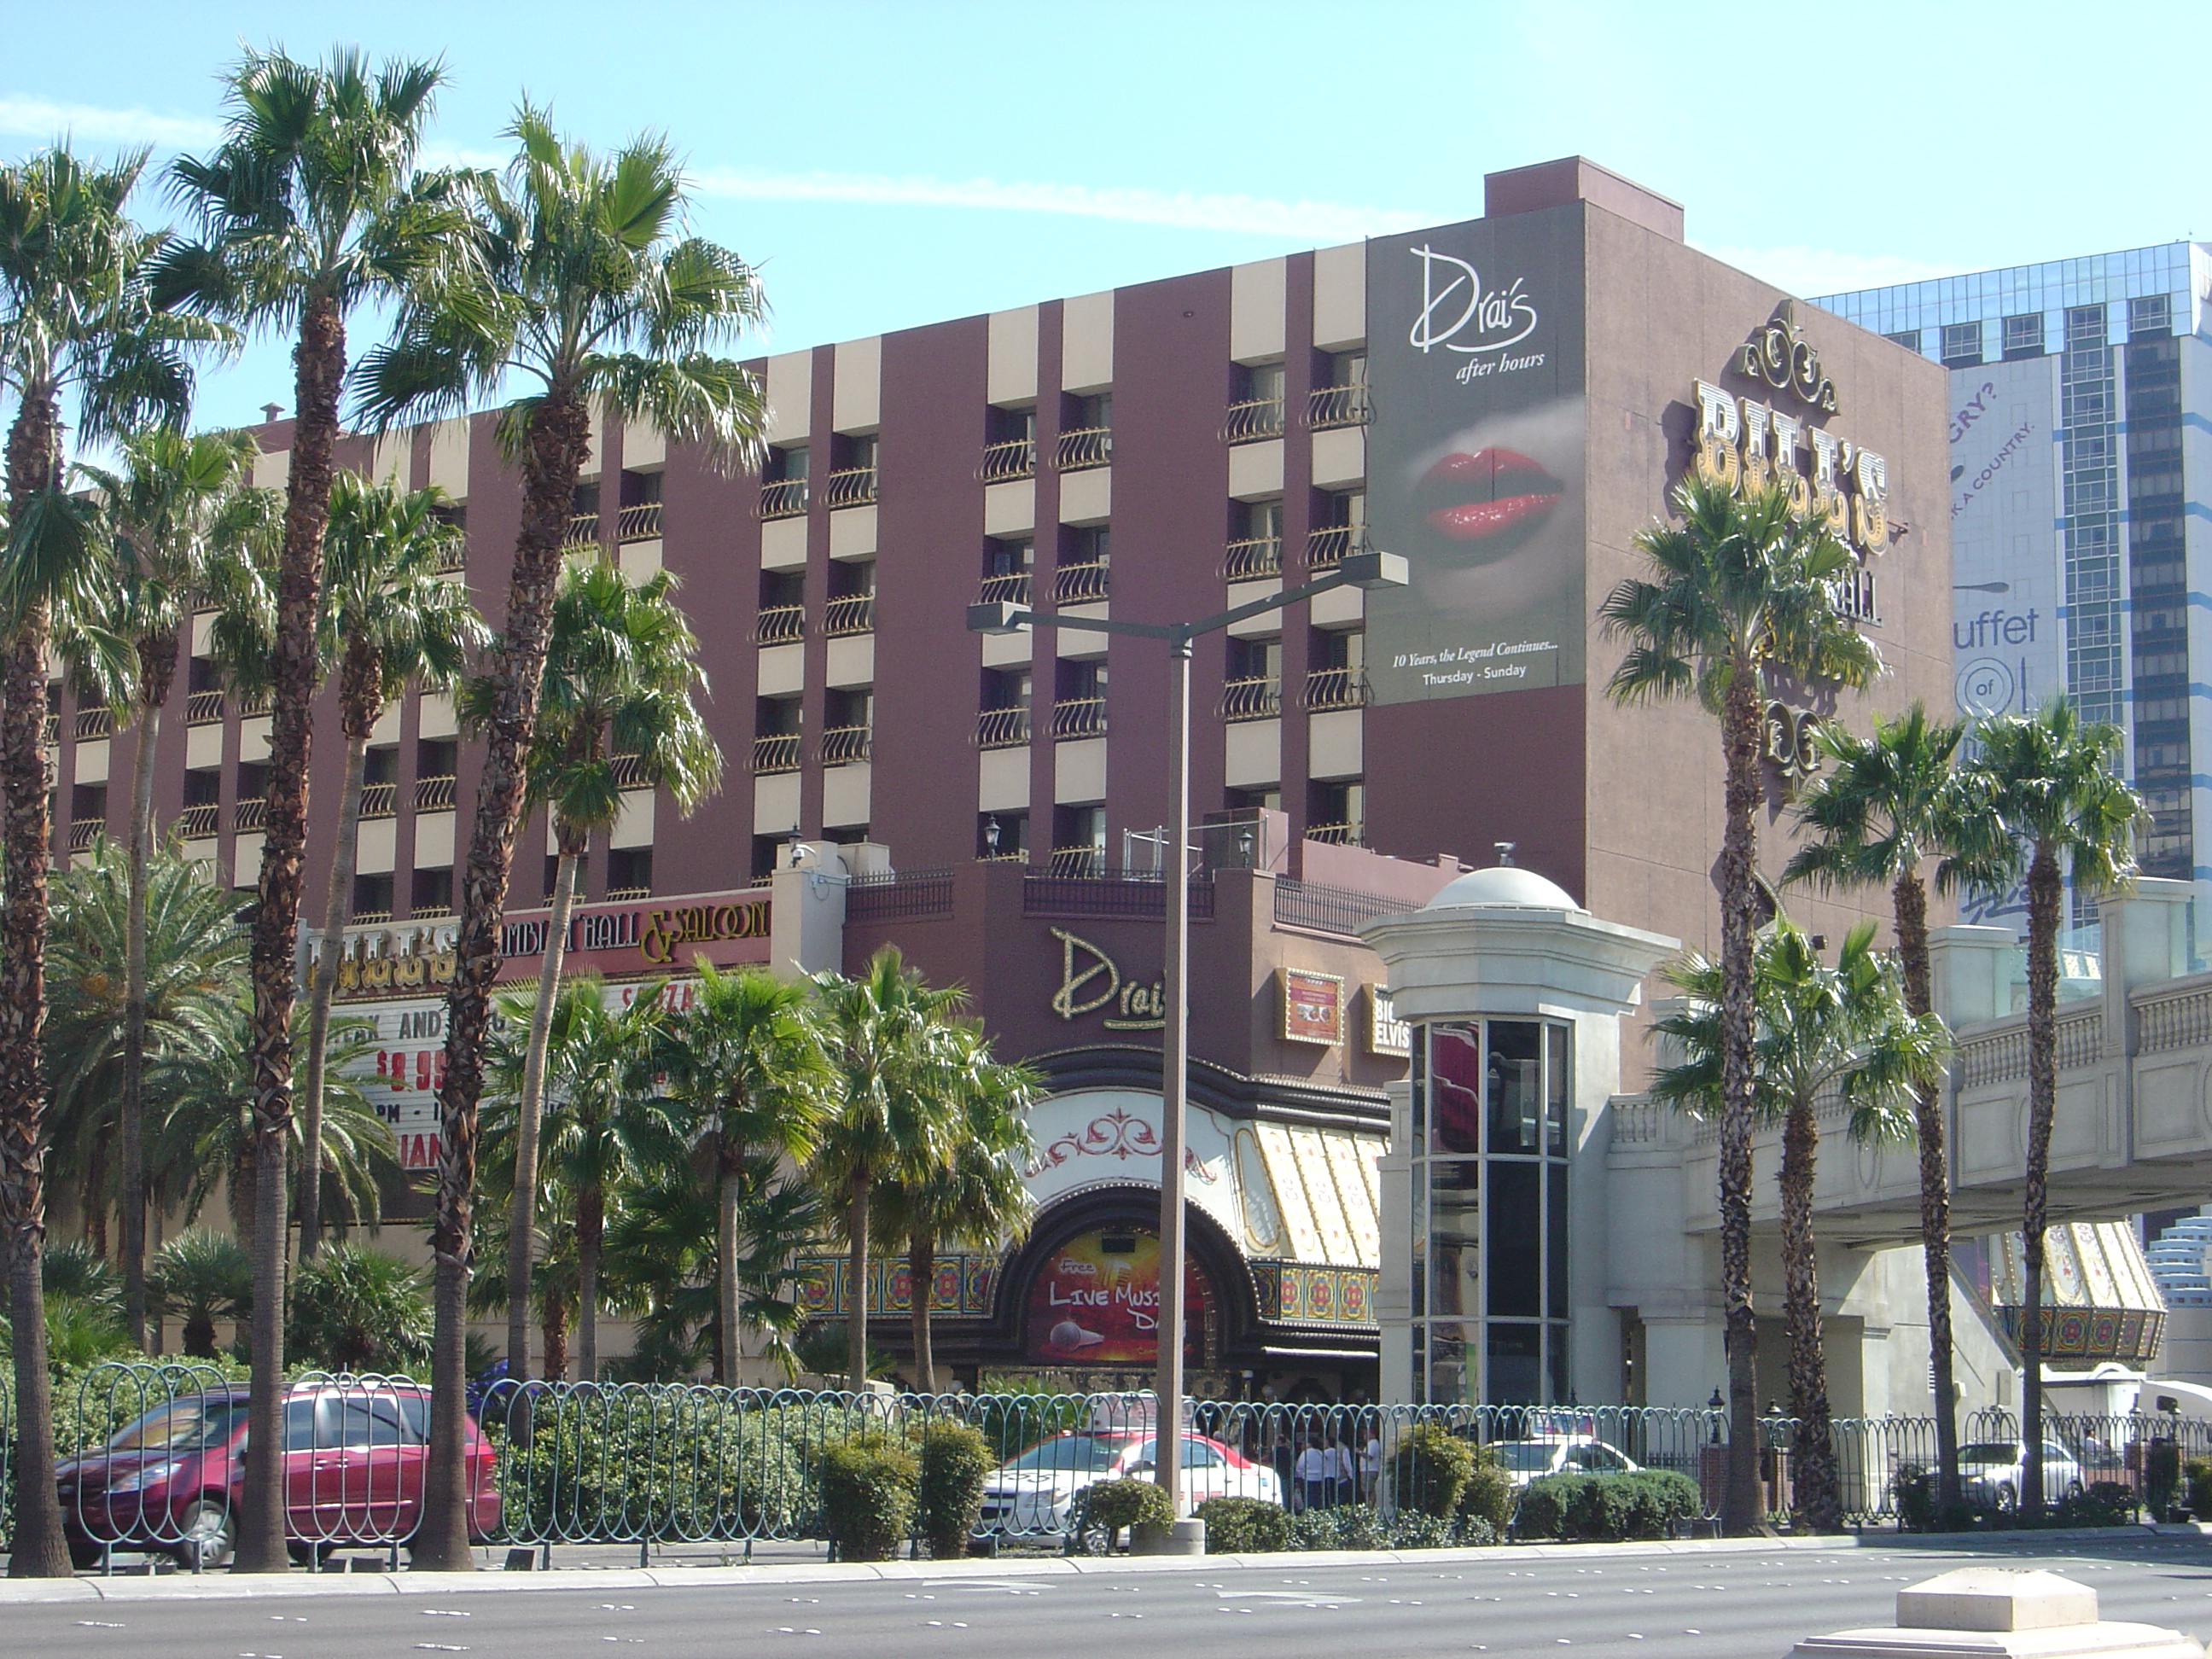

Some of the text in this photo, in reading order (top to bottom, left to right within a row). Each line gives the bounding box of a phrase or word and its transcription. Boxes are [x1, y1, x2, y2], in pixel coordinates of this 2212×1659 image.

[1410, 243, 1537, 352] Drai's
[1456, 353, 1545, 384] after hours
[1964, 492, 1974, 504] A
[1393, 640, 1558, 667] 10 Years, the Legend Continues...
[1423, 670, 1474, 685] Thursday
[1484, 664, 1527, 679] Sunday
[1976, 678, 1994, 696] of
[581, 912, 640, 951] HALL
[640, 910, 672, 963] &
[672, 900, 770, 942] SALOON
[399, 1010, 442, 1039] AND
[1375, 1023, 1410, 1049] ELVIS
[1060, 1258, 1097, 1274] Free
[1050, 1281, 1109, 1307] LIVE
